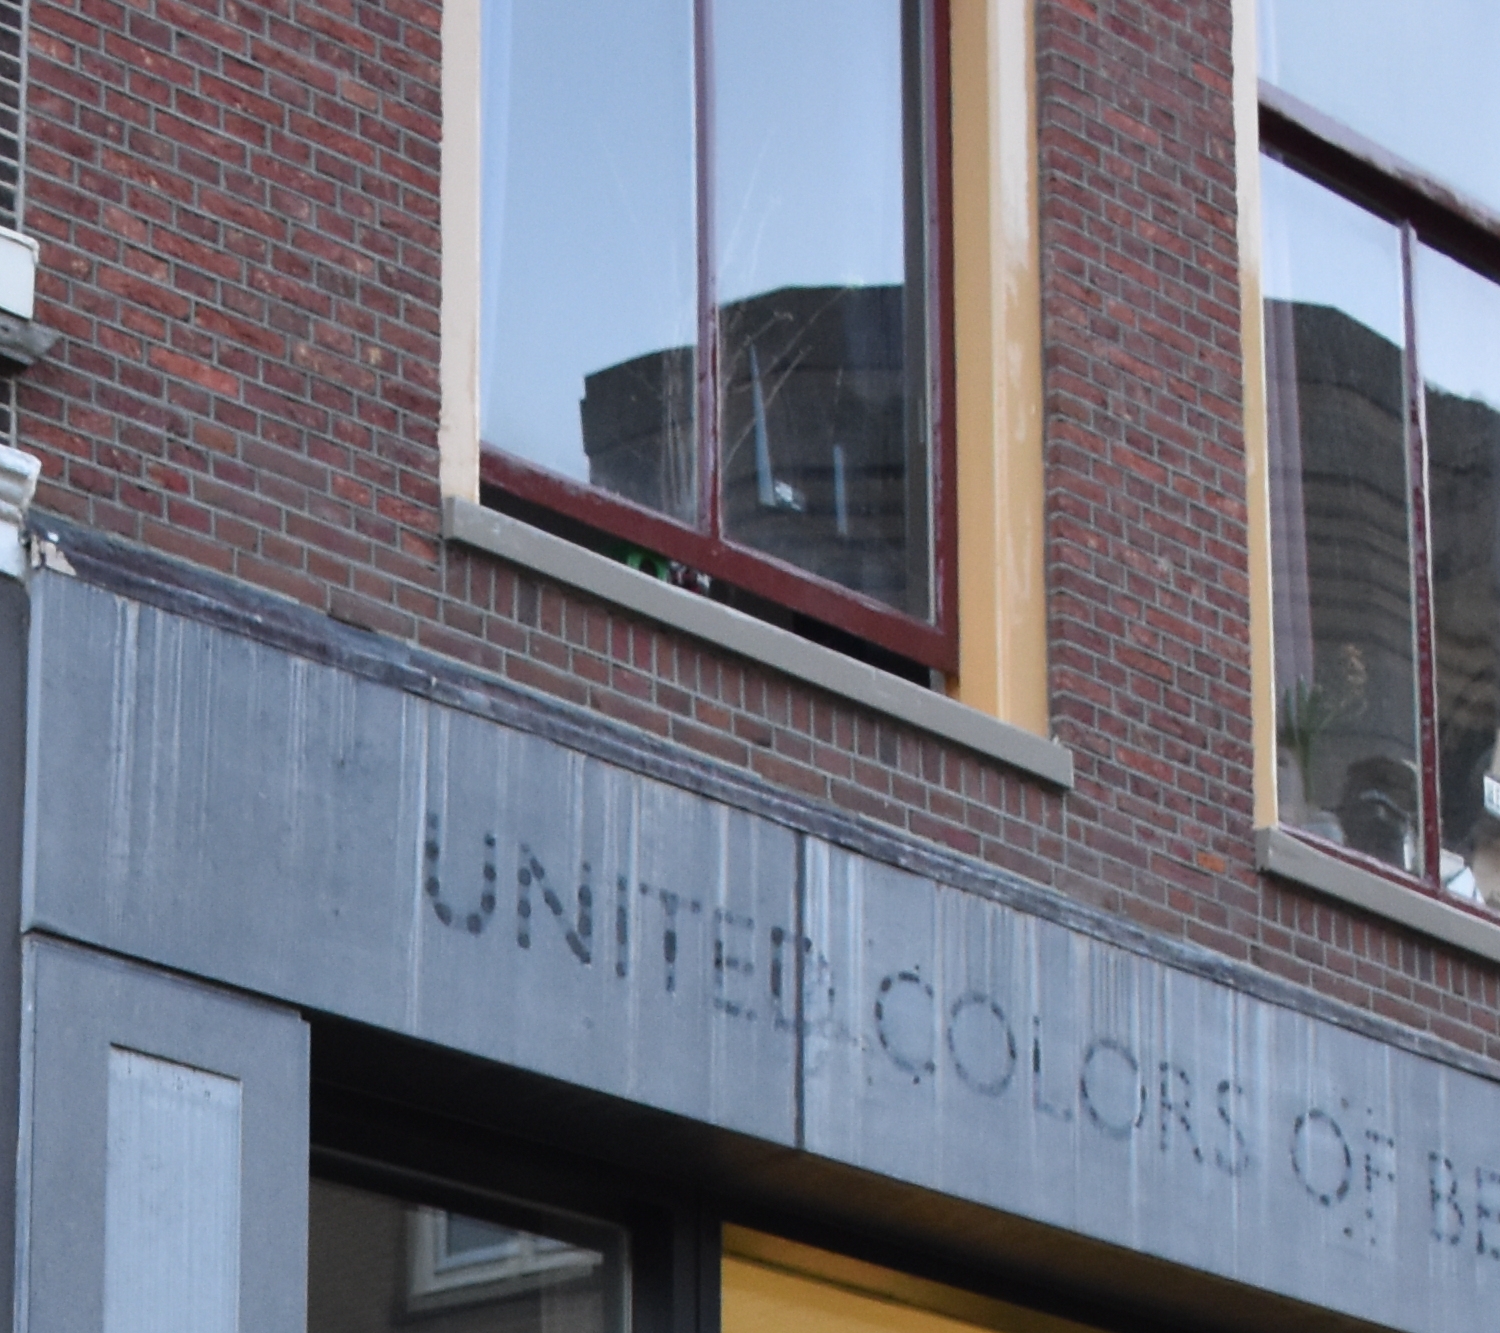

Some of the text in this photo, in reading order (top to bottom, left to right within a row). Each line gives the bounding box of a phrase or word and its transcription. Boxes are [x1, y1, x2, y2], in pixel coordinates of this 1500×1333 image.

[425, 812, 838, 1034] UNITED
[875, 971, 1250, 1177] COLORS
[1291, 1108, 1396, 1224] OF
